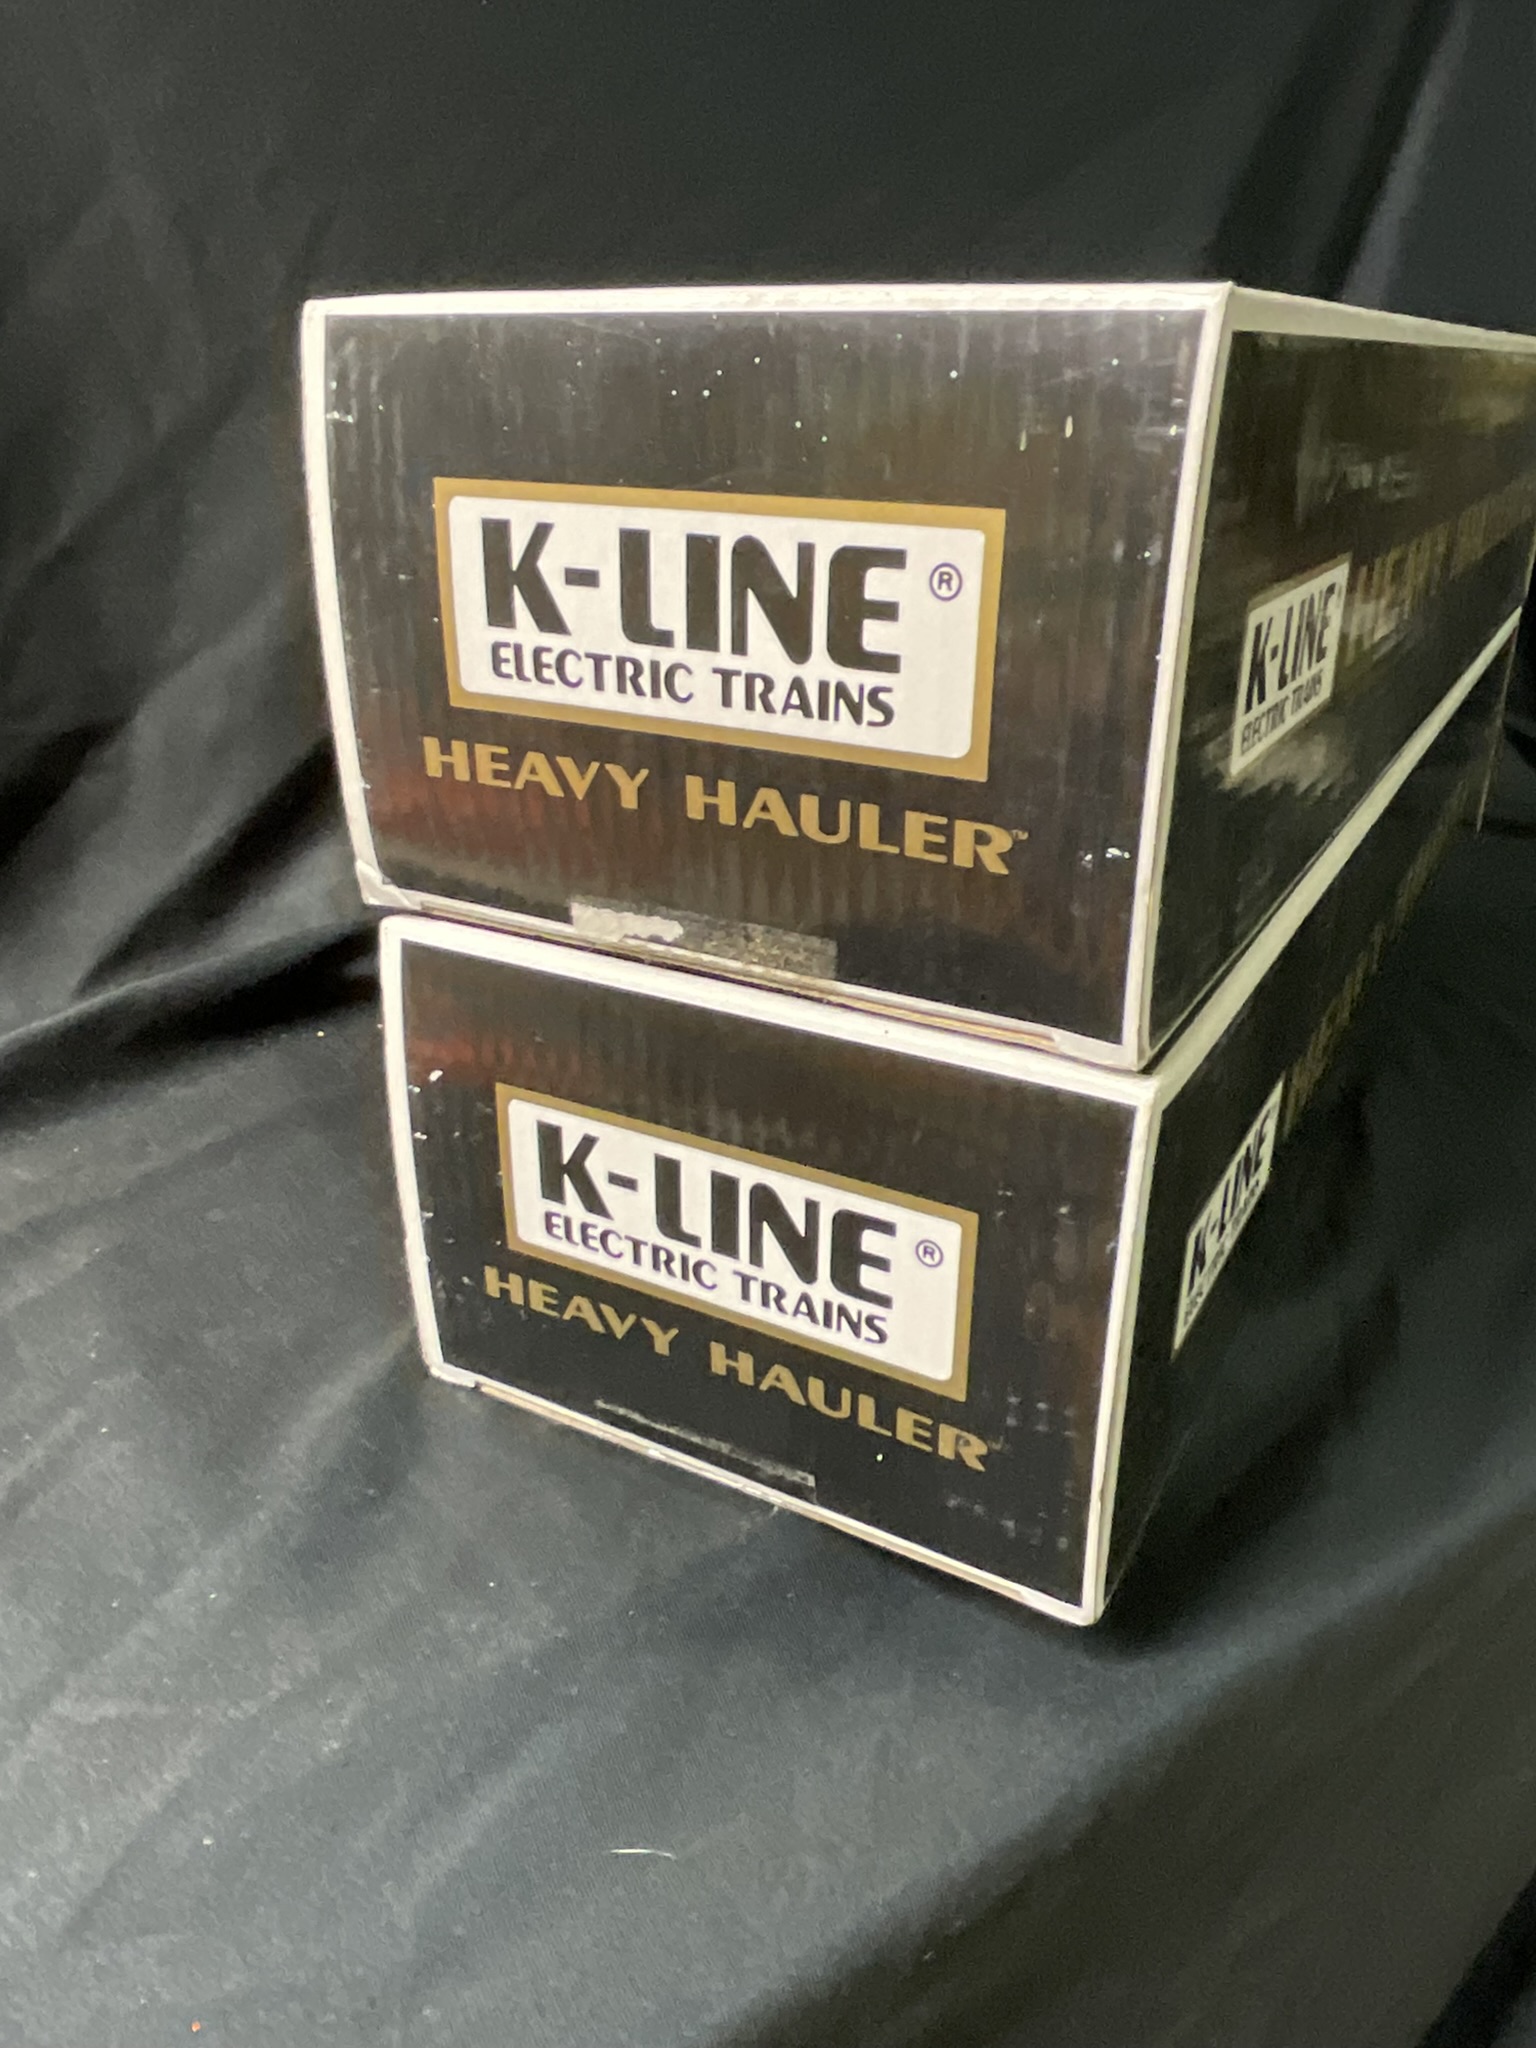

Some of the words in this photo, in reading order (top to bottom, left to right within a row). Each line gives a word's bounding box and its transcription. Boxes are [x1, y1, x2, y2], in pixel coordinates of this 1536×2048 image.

[481, 517, 907, 673] K-LINE
[1244, 582, 1337, 715] K-LINE
[491, 641, 694, 703] ELECTRIC
[712, 667, 894, 728] TRAINS
[421, 736, 649, 810] HEAVY
[685, 775, 1013, 875] HAULER
[536, 1120, 897, 1309] K-LINE
[544, 1211, 718, 1291] ELECTRIC
[733, 1270, 888, 1345] TRAINS
[483, 1265, 679, 1357] HEAVY
[709, 1341, 988, 1472] HAULER
